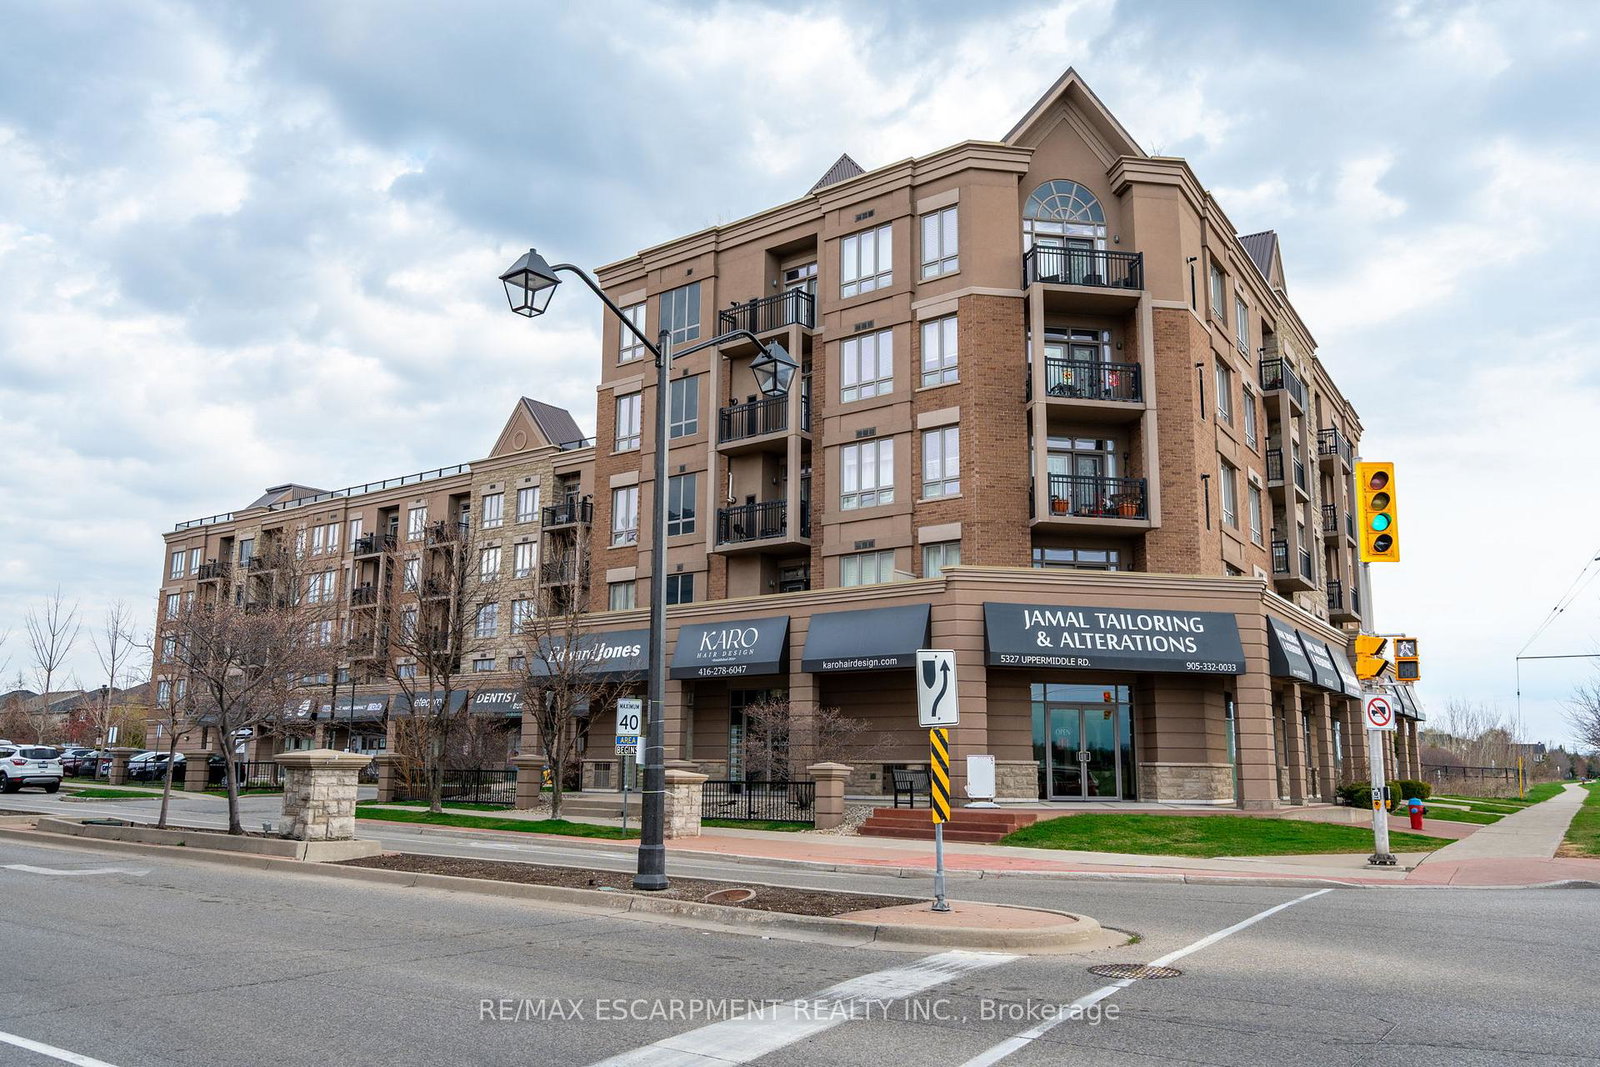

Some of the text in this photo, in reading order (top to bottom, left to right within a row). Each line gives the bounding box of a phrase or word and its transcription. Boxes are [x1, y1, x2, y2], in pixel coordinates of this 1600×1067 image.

[1024, 610, 1204, 633] JAMAL TAILORING
[700, 627, 759, 651] KARO
[1036, 631, 1197, 653] & ALTERATIONS
[594, 642, 641, 662] Jones
[696, 648, 755, 659] HAIR DESIGN
[822, 658, 898, 669] karohairdesign.com
[1000, 654, 1091, 667] 5327 UPPERMIDDLE RD.
[1186, 661, 1237, 672] 905-332-0033
[698, 665, 747, 676] 416-278-6047
[619, 714, 639, 730] 40
